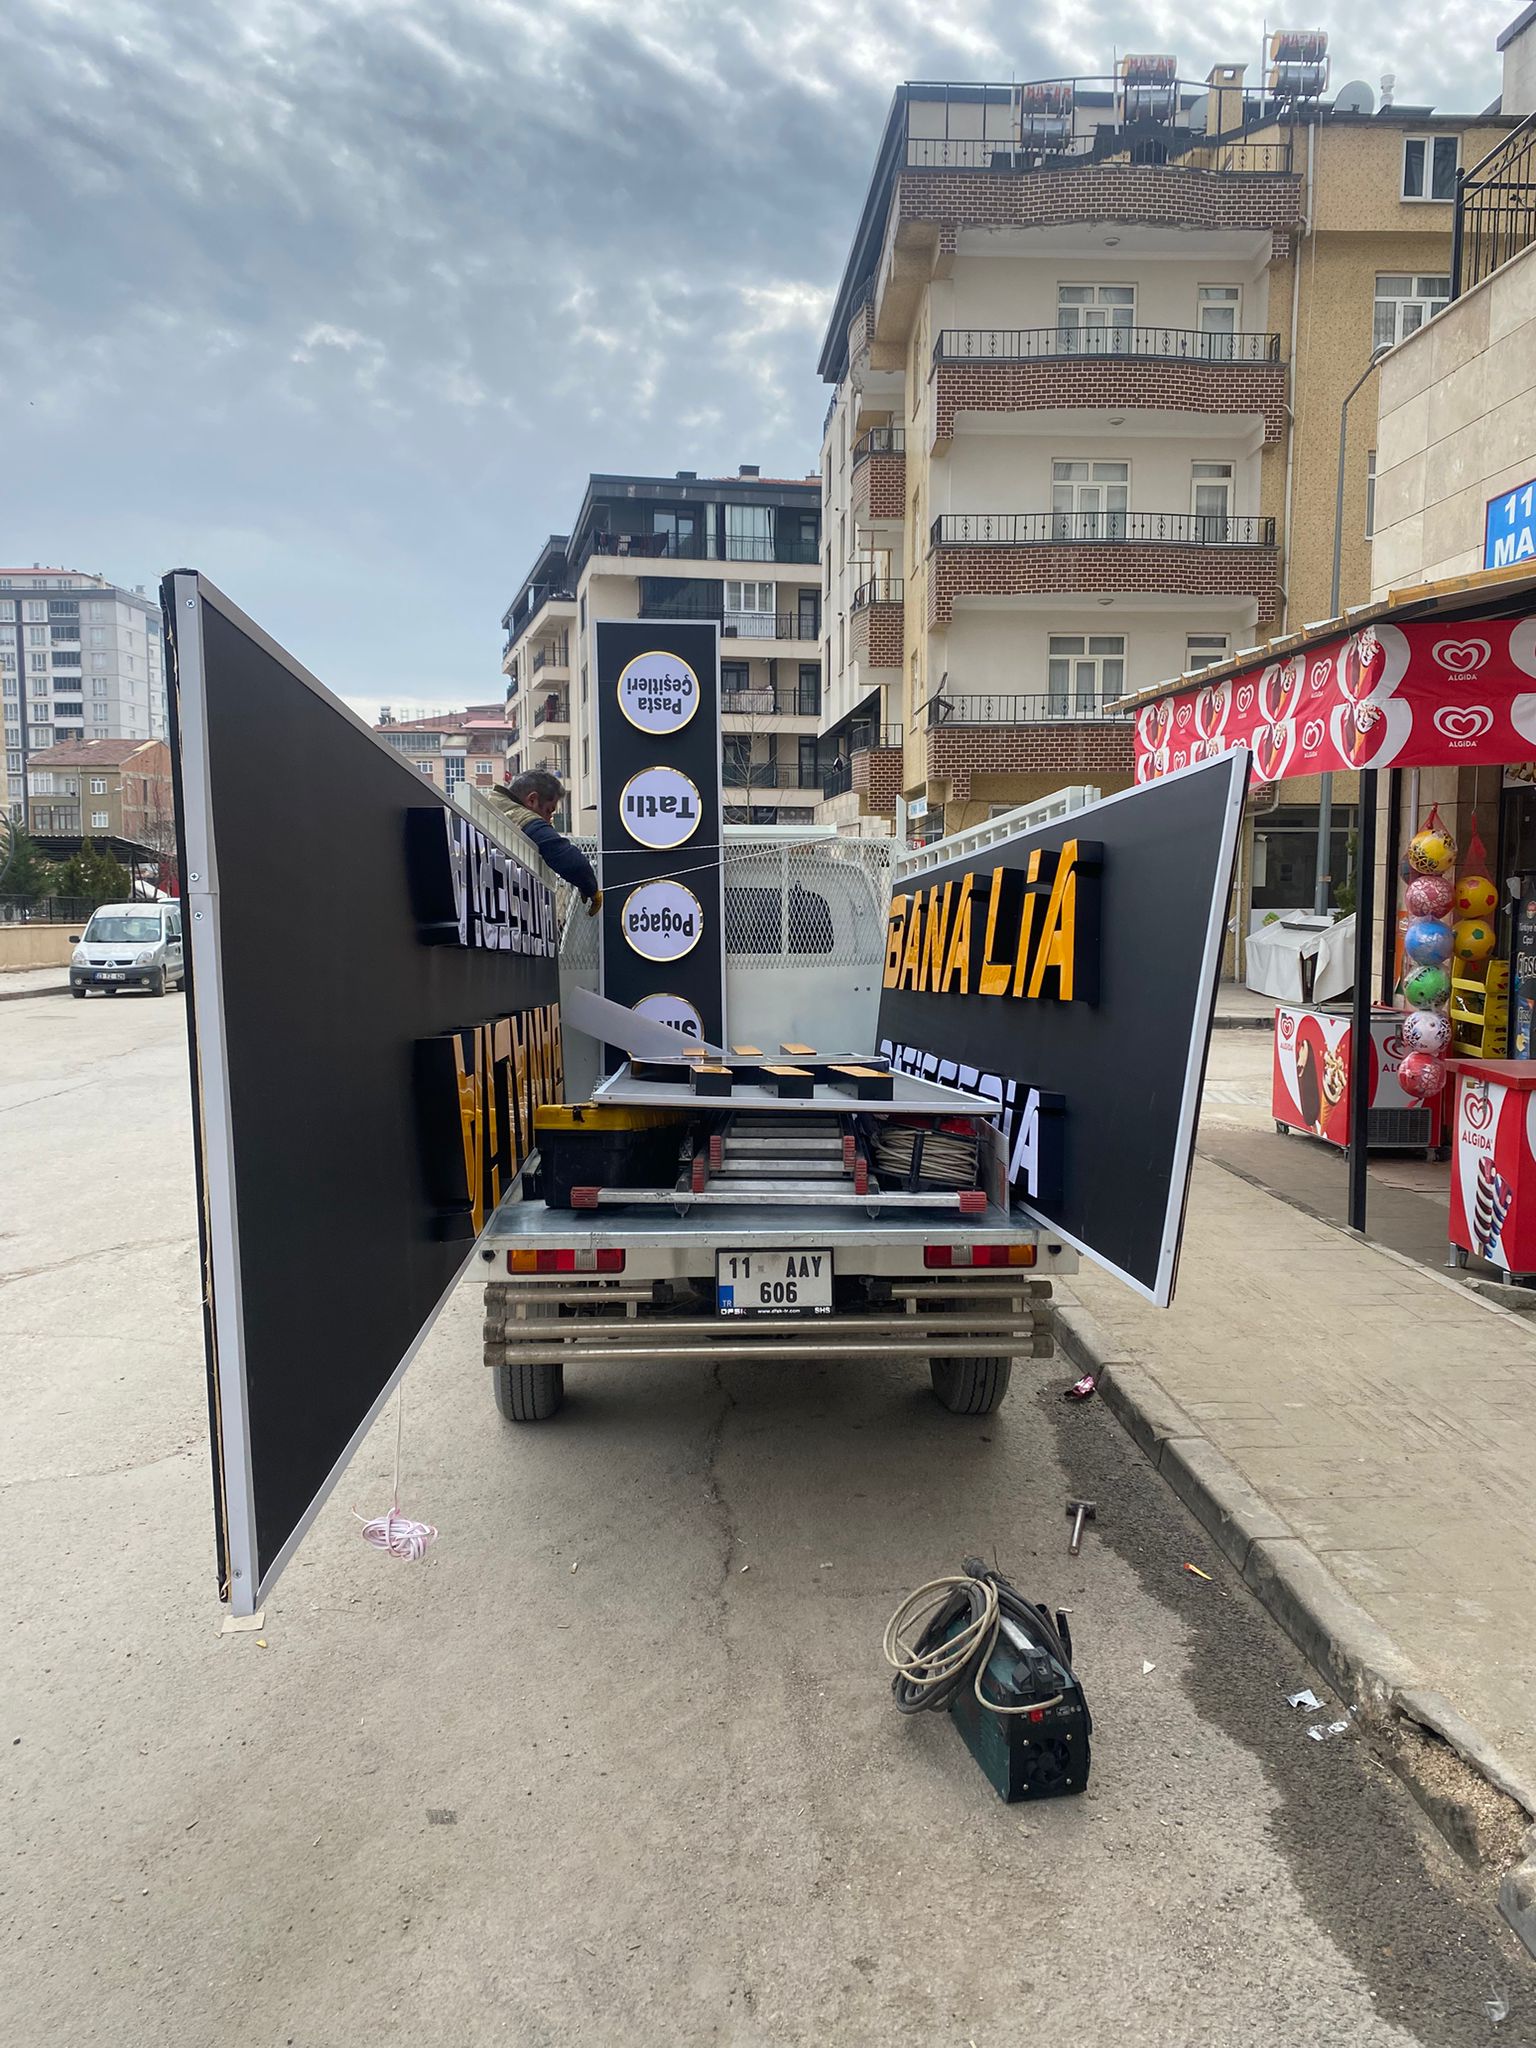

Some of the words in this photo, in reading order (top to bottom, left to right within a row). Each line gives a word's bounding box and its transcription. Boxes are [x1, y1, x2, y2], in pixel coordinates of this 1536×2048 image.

[627, 673, 693, 696] Çeşitleri
[638, 697, 682, 715] Pasta
[627, 795, 695, 819] Tatlı
[629, 906, 694, 938] Poğaça
[728, 1256, 750, 1279] 11
[785, 1255, 822, 1278] AAY
[722, 1299, 733, 1307] TR
[760, 1281, 798, 1304] 606
